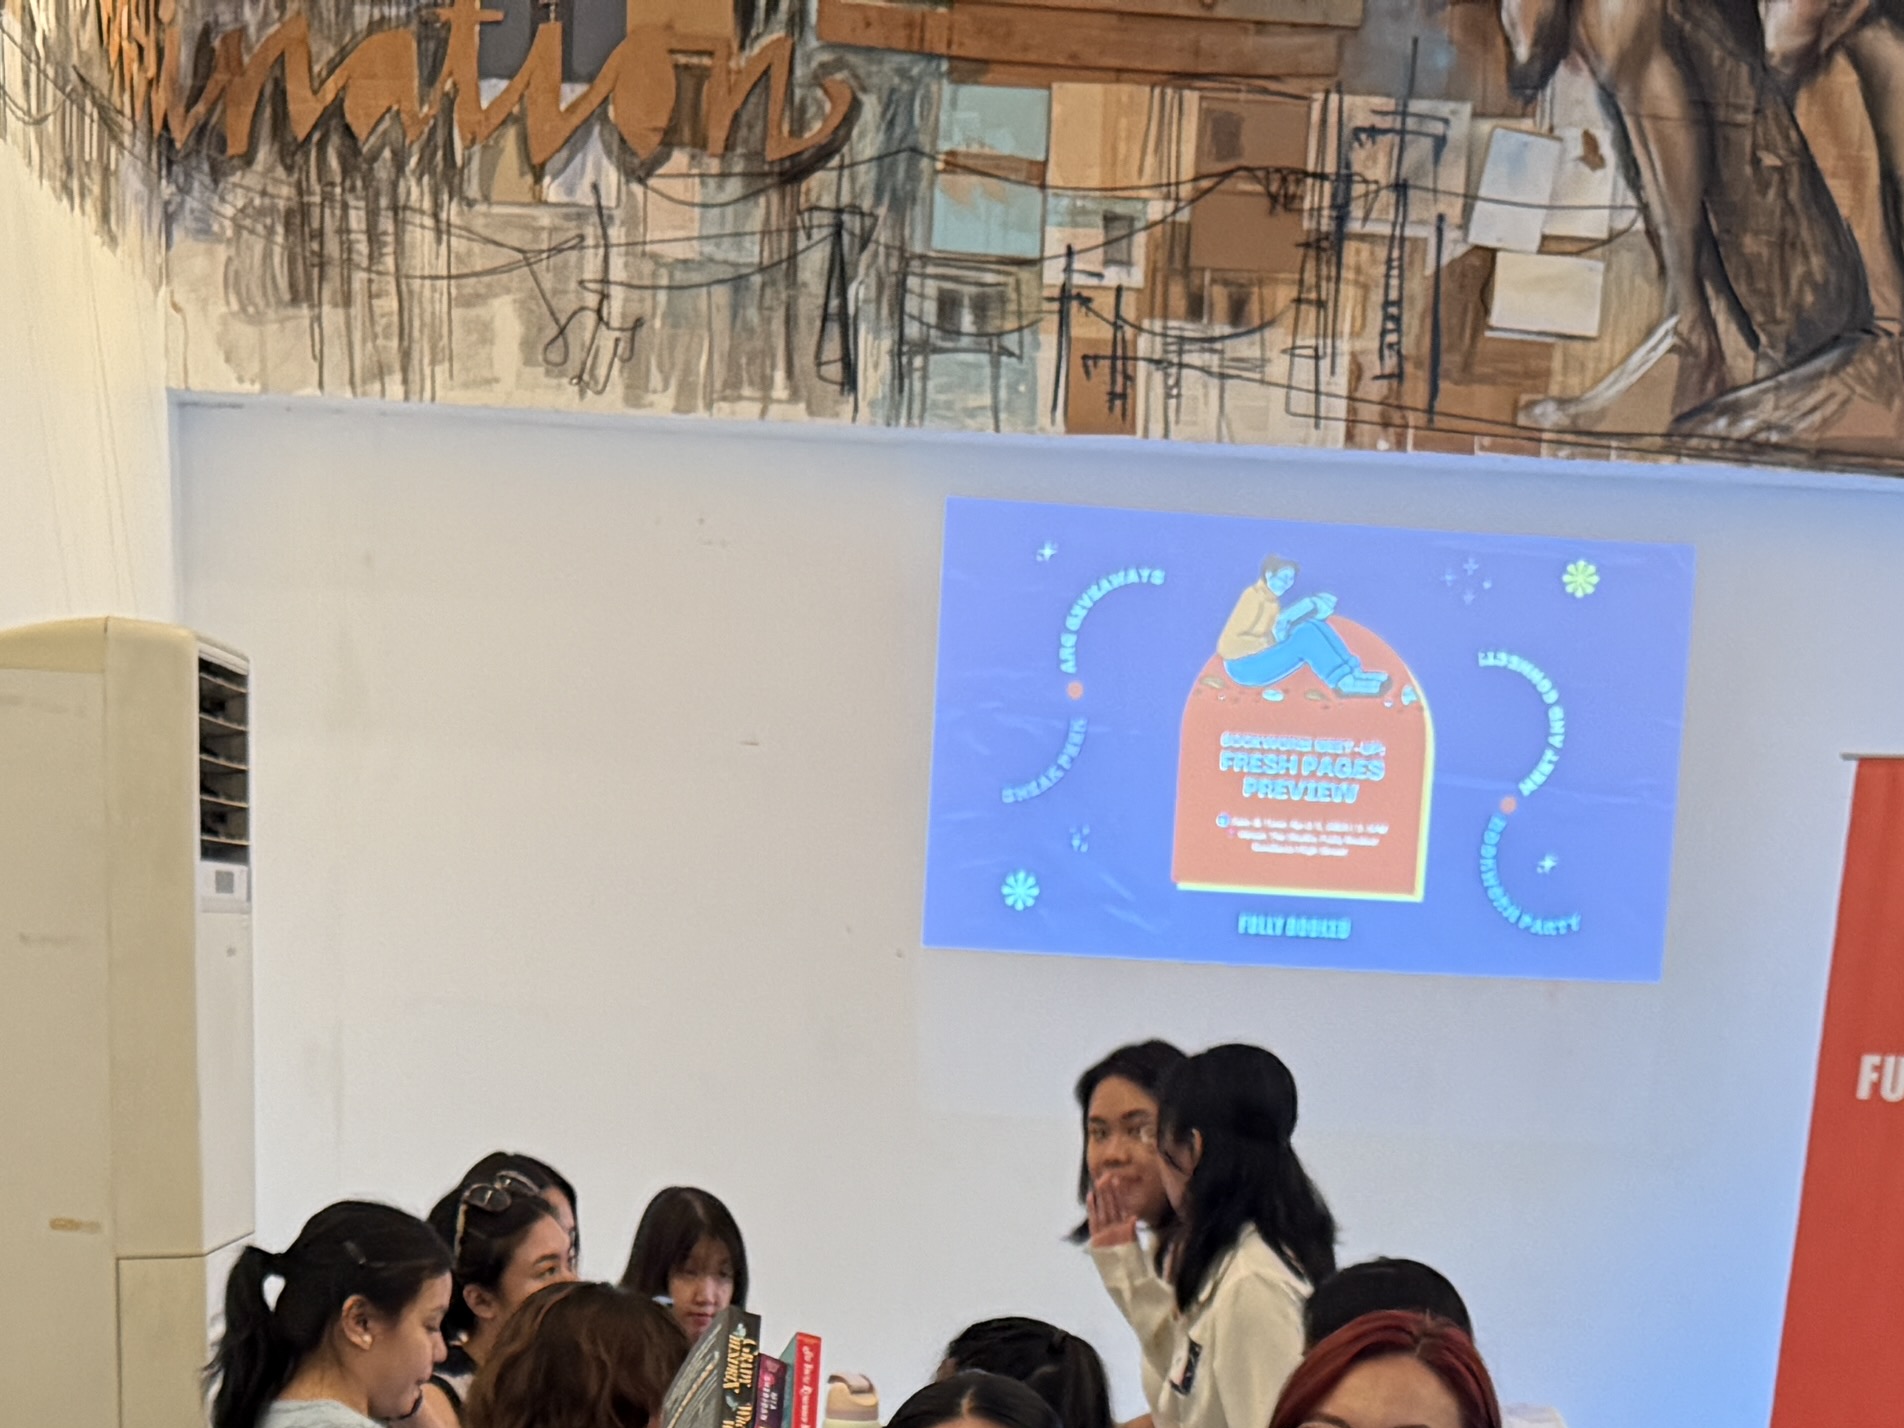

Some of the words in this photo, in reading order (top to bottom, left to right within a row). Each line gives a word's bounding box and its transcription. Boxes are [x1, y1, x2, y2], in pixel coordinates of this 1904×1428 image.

[1220, 750, 1299, 775] FRESH
[1301, 755, 1385, 781] PAGES
[1242, 775, 1360, 804] PREVIEW
